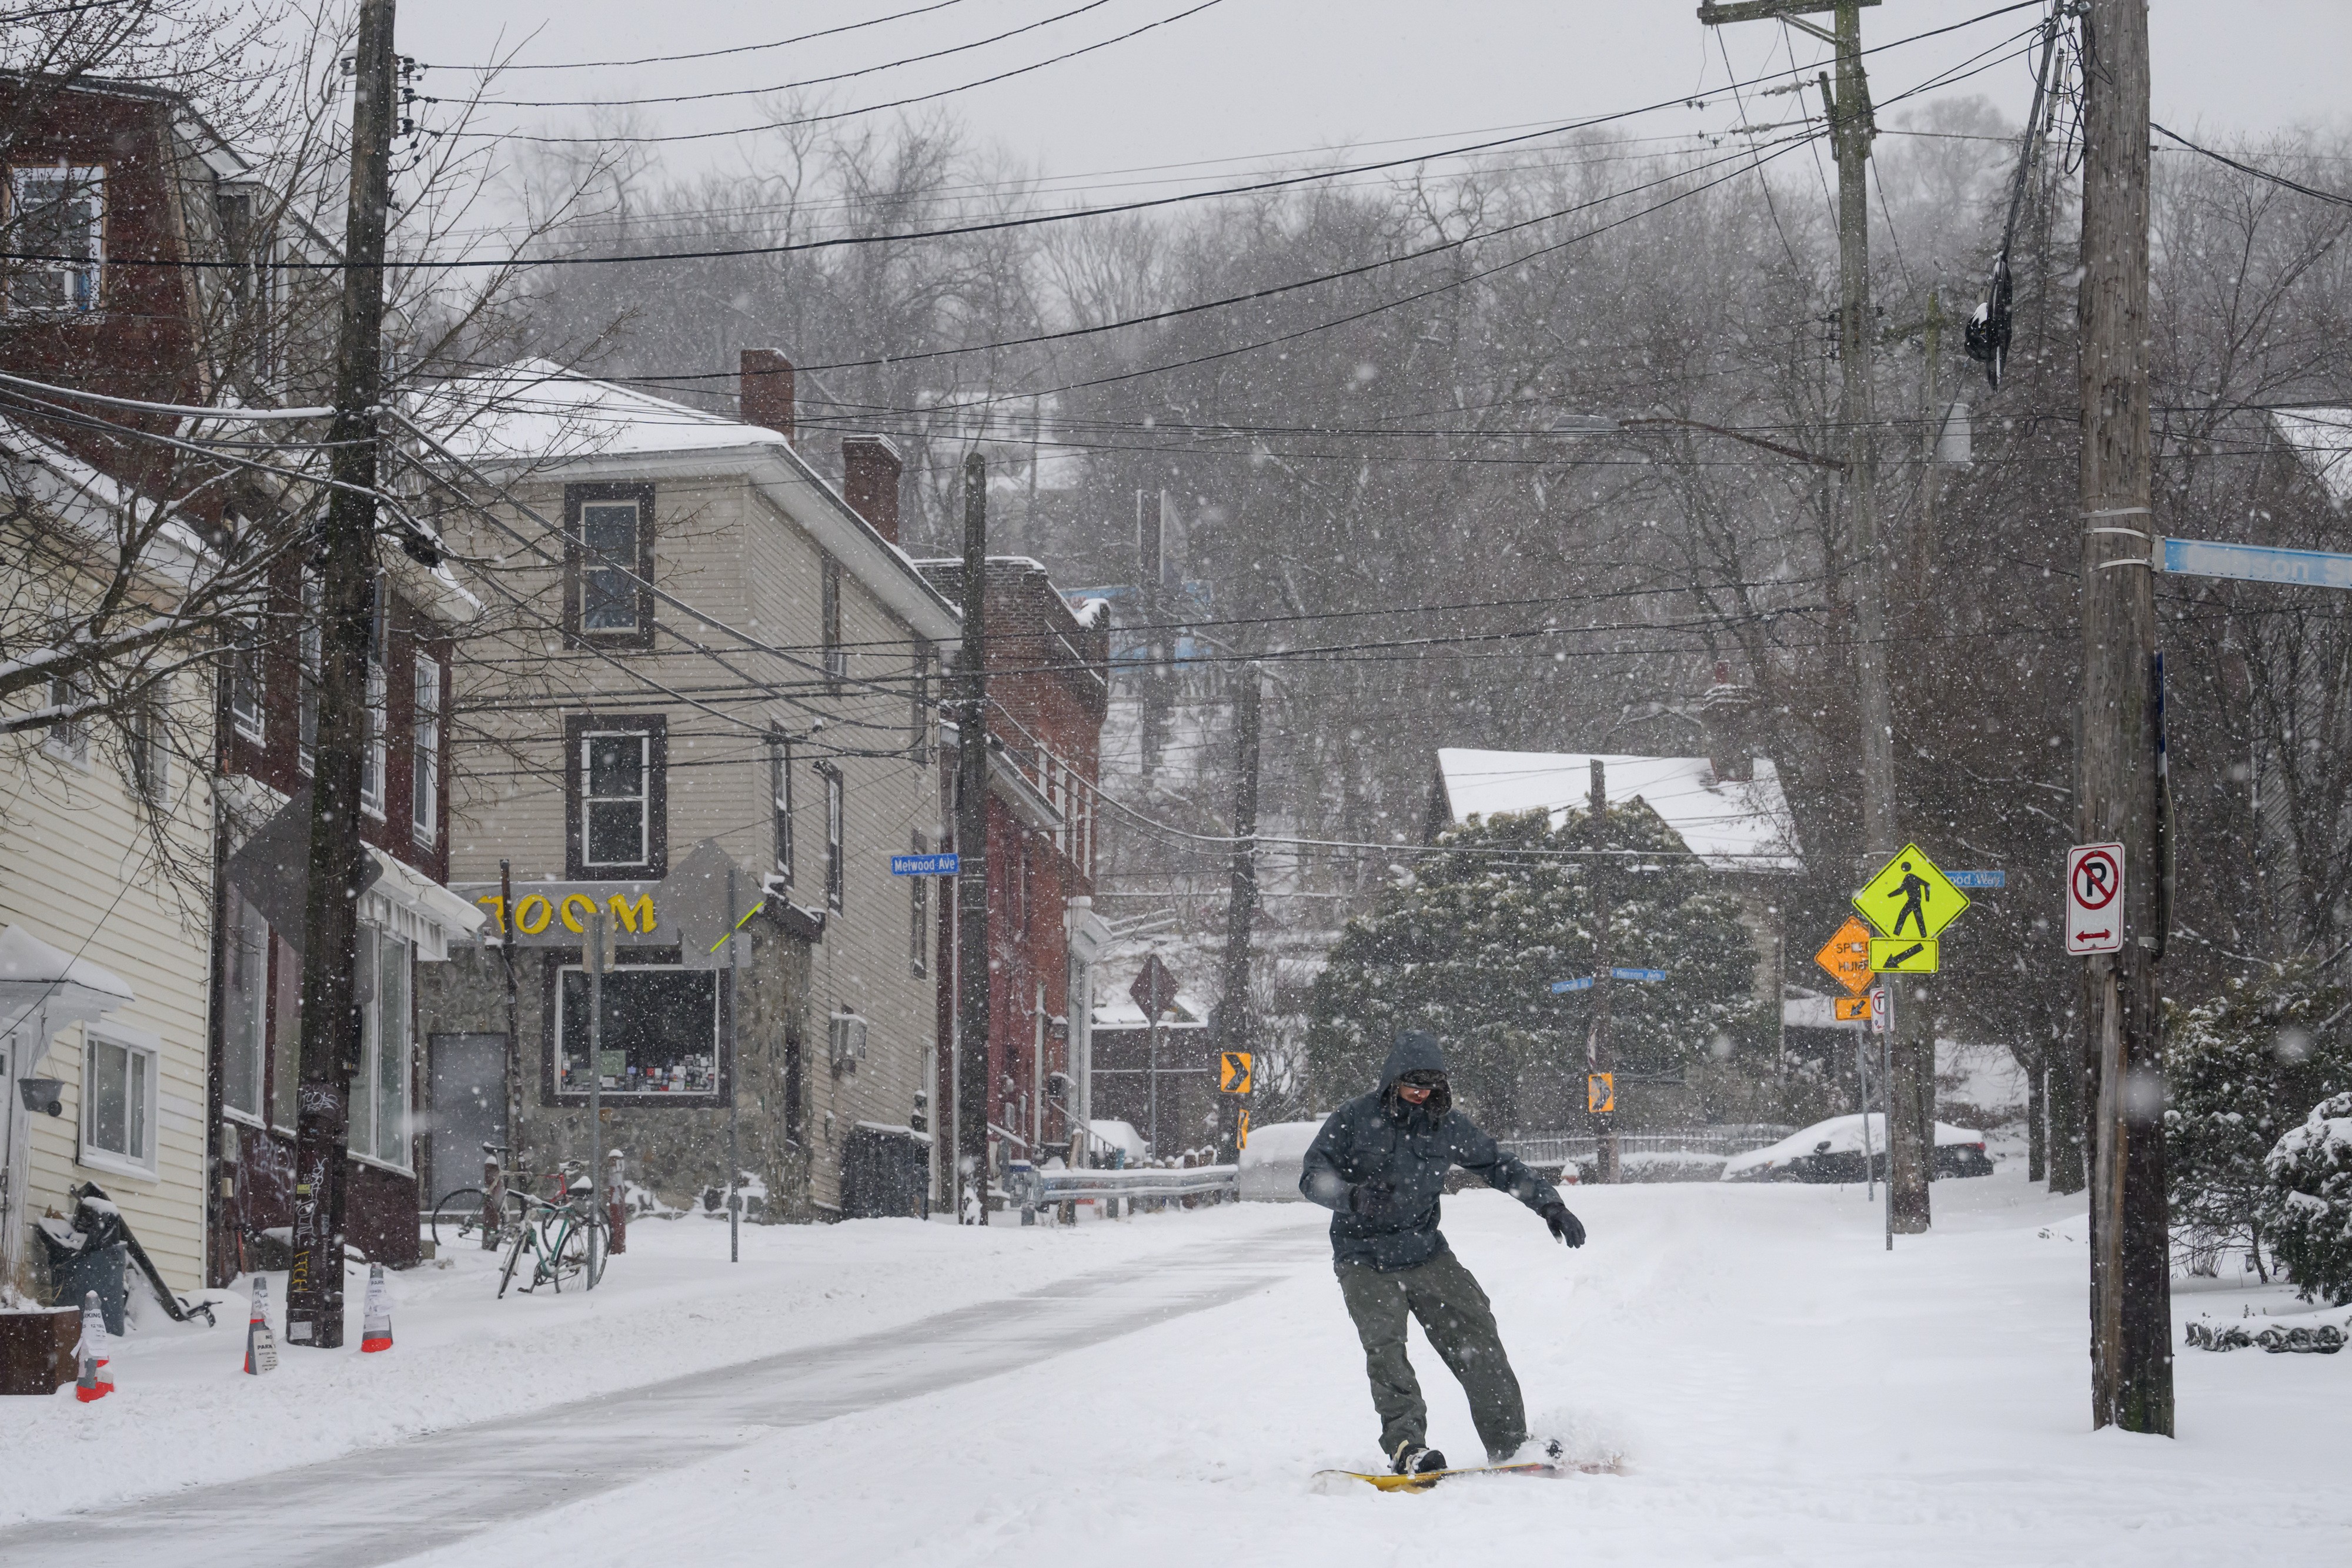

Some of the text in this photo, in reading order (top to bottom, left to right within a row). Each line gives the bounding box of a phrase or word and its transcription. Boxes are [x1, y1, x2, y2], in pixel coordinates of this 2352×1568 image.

[2324, 558, 2352, 583] S
[894, 858, 955, 871] Melwood Ave
[1946, 873, 2000, 887] ood Way
